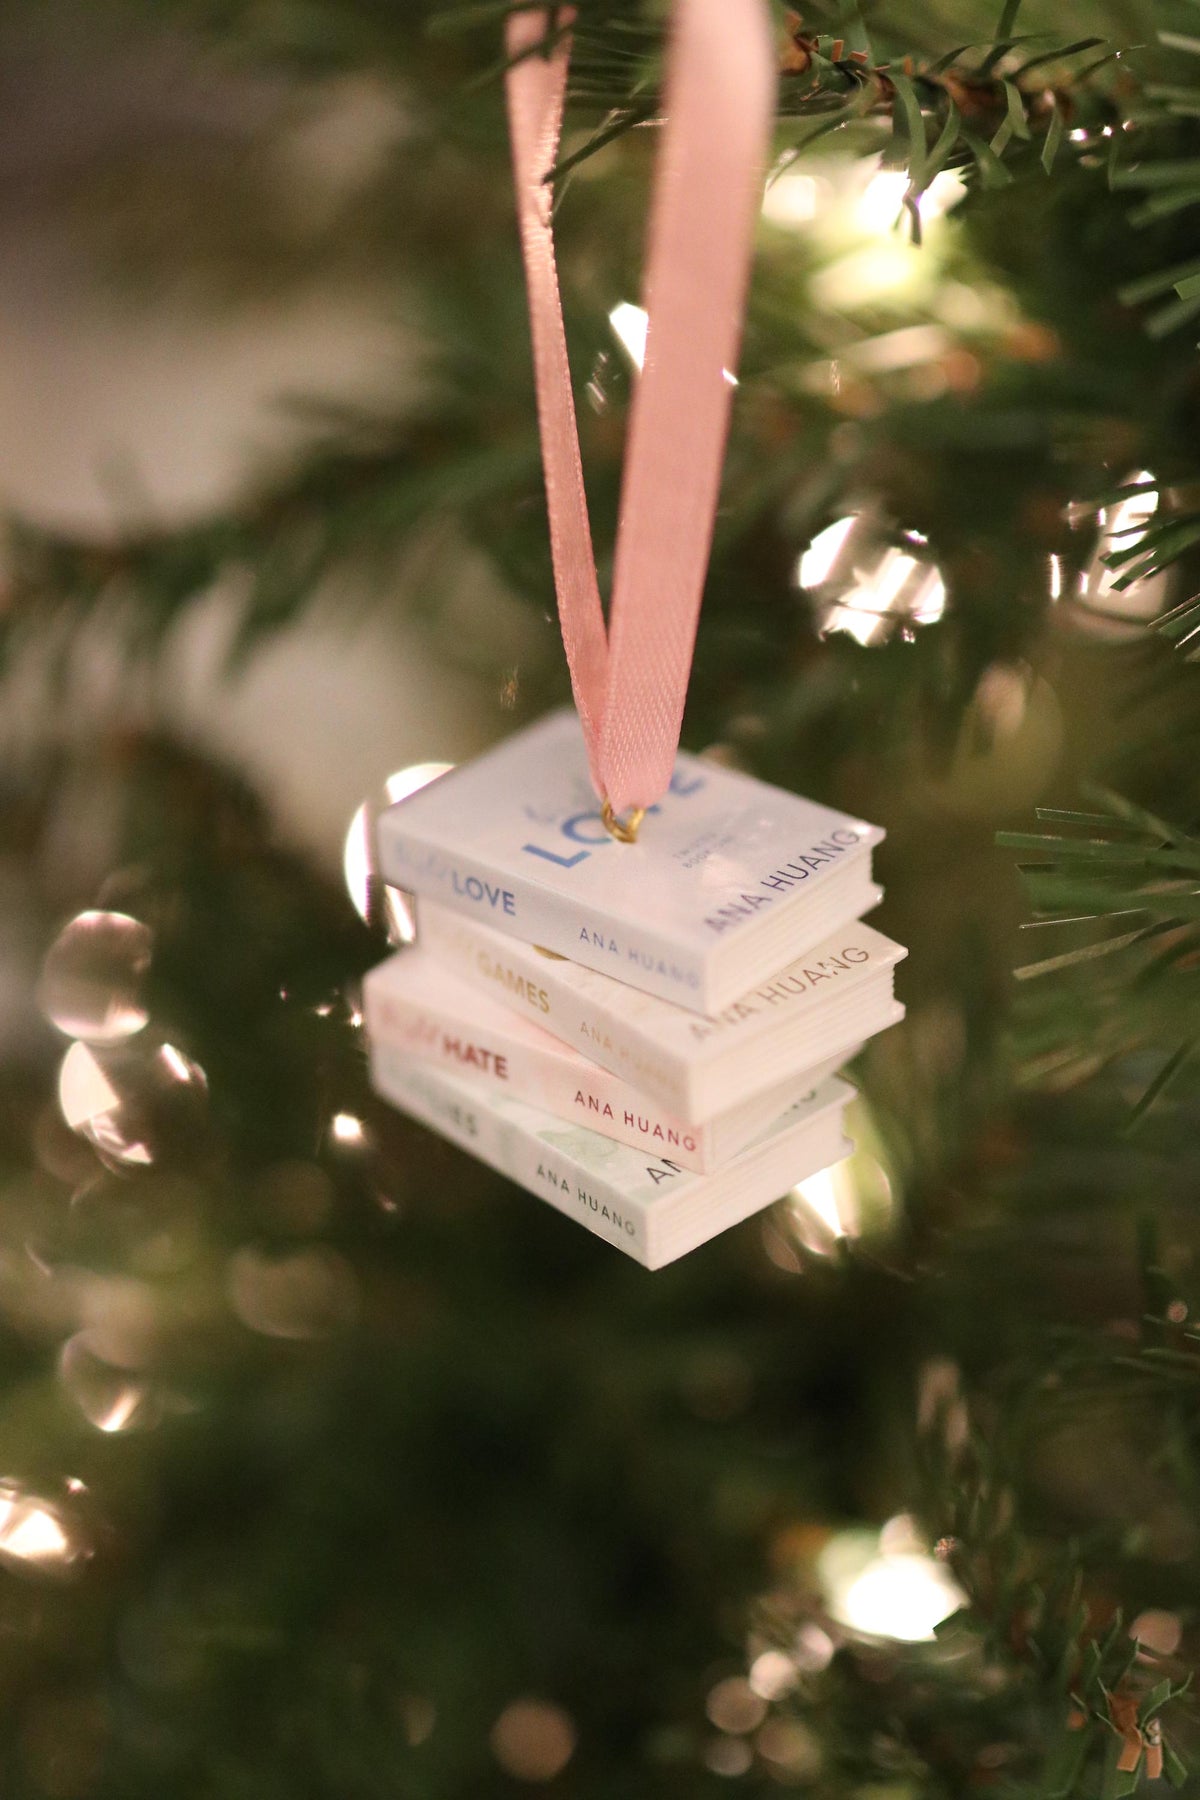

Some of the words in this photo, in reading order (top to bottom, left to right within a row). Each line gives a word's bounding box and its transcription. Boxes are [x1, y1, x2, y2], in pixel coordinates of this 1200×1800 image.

[453, 870, 517, 917] LOVE
[704, 893, 772, 934] ANA
[761, 829, 861, 892] HUANG
[579, 926, 618, 954] ANA
[475, 951, 551, 1014] GAMES
[757, 947, 870, 1007] HUANG
[443, 1035, 509, 1081] HATE
[574, 1089, 614, 1120] ANA
[623, 1110, 697, 1152] HUANG
[536, 1163, 570, 1195] ANA
[577, 1187, 636, 1237] HUANG
